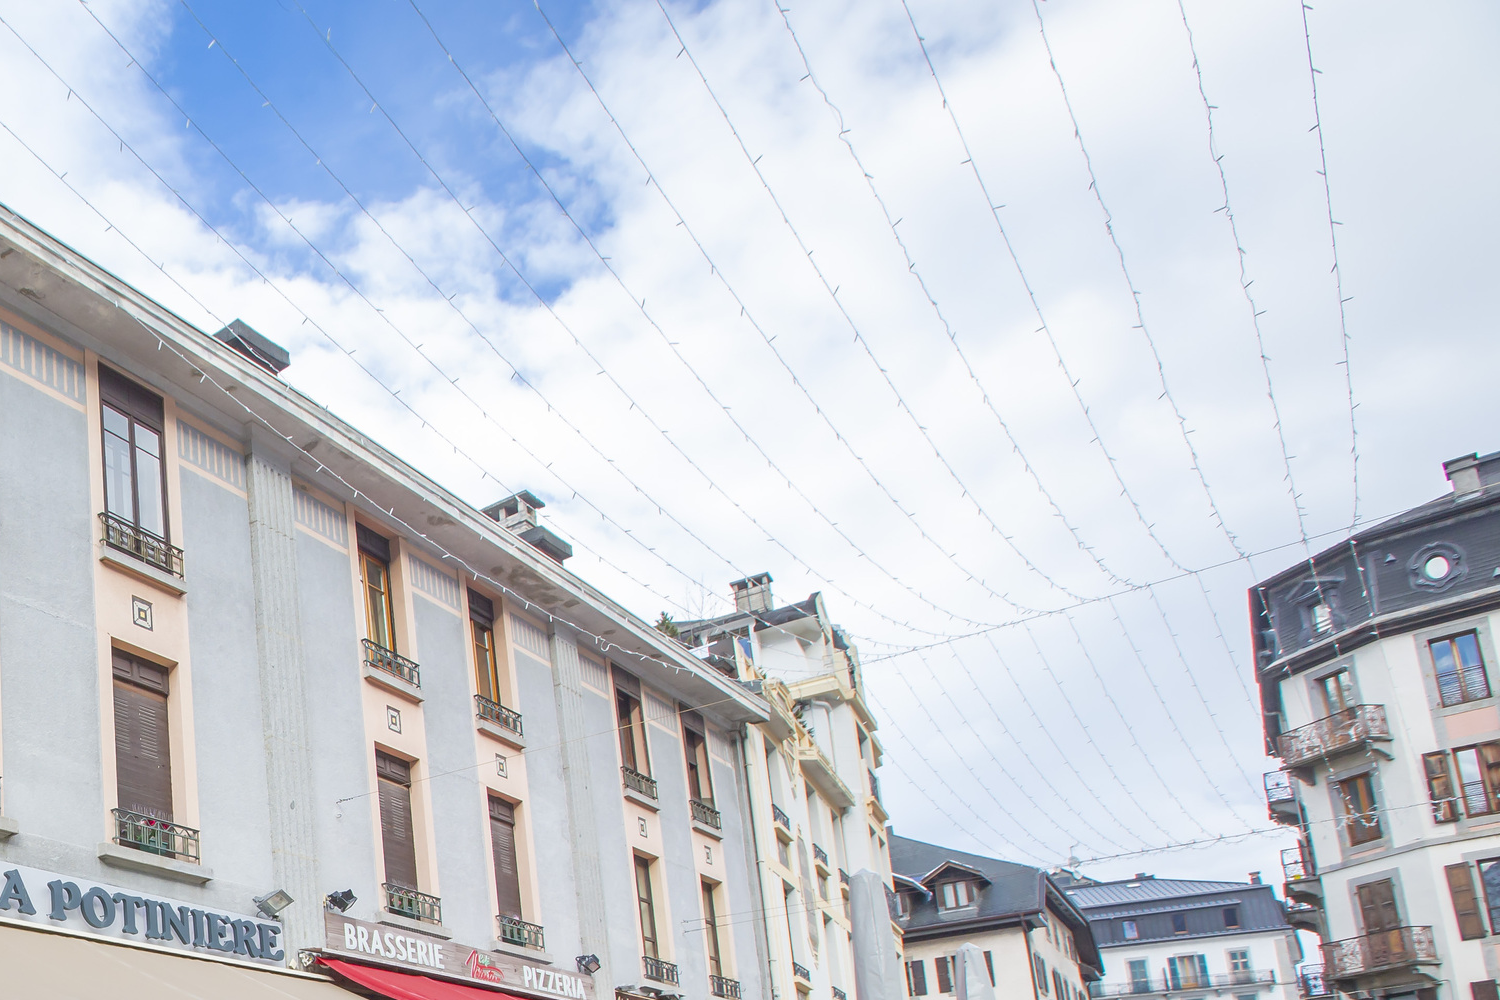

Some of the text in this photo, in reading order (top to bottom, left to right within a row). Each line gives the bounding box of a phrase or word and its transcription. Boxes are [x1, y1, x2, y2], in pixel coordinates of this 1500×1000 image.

[47, 879, 285, 962] POTINIERE
[344, 922, 445, 970] BRASSERIE
[523, 965, 588, 1000] PIZZERIA
